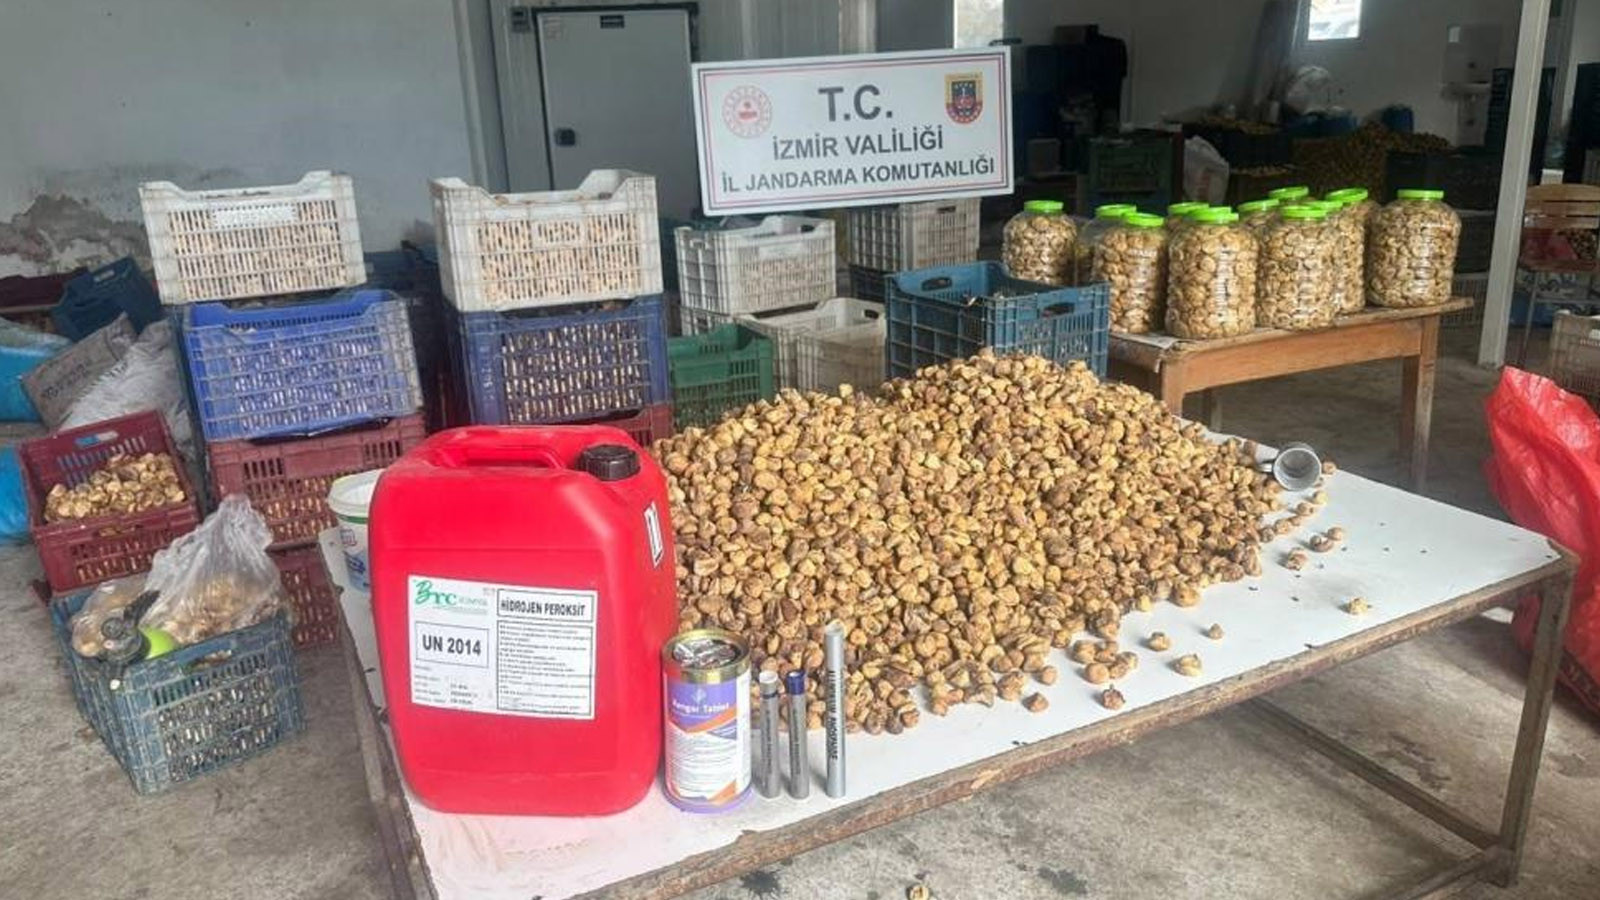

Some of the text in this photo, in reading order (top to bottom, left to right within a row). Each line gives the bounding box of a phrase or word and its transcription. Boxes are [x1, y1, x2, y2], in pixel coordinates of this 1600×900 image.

[818, 84, 893, 122] T.C.
[772, 125, 943, 161] İZMİR VALİLİĞİ
[722, 155, 995, 193] İL JANDARMA KOMUTANLIĞI
[500, 597, 543, 614] HİDROJEN
[544, 602, 586, 616] PEROKSİT
[422, 634, 481, 656] UN 2014
